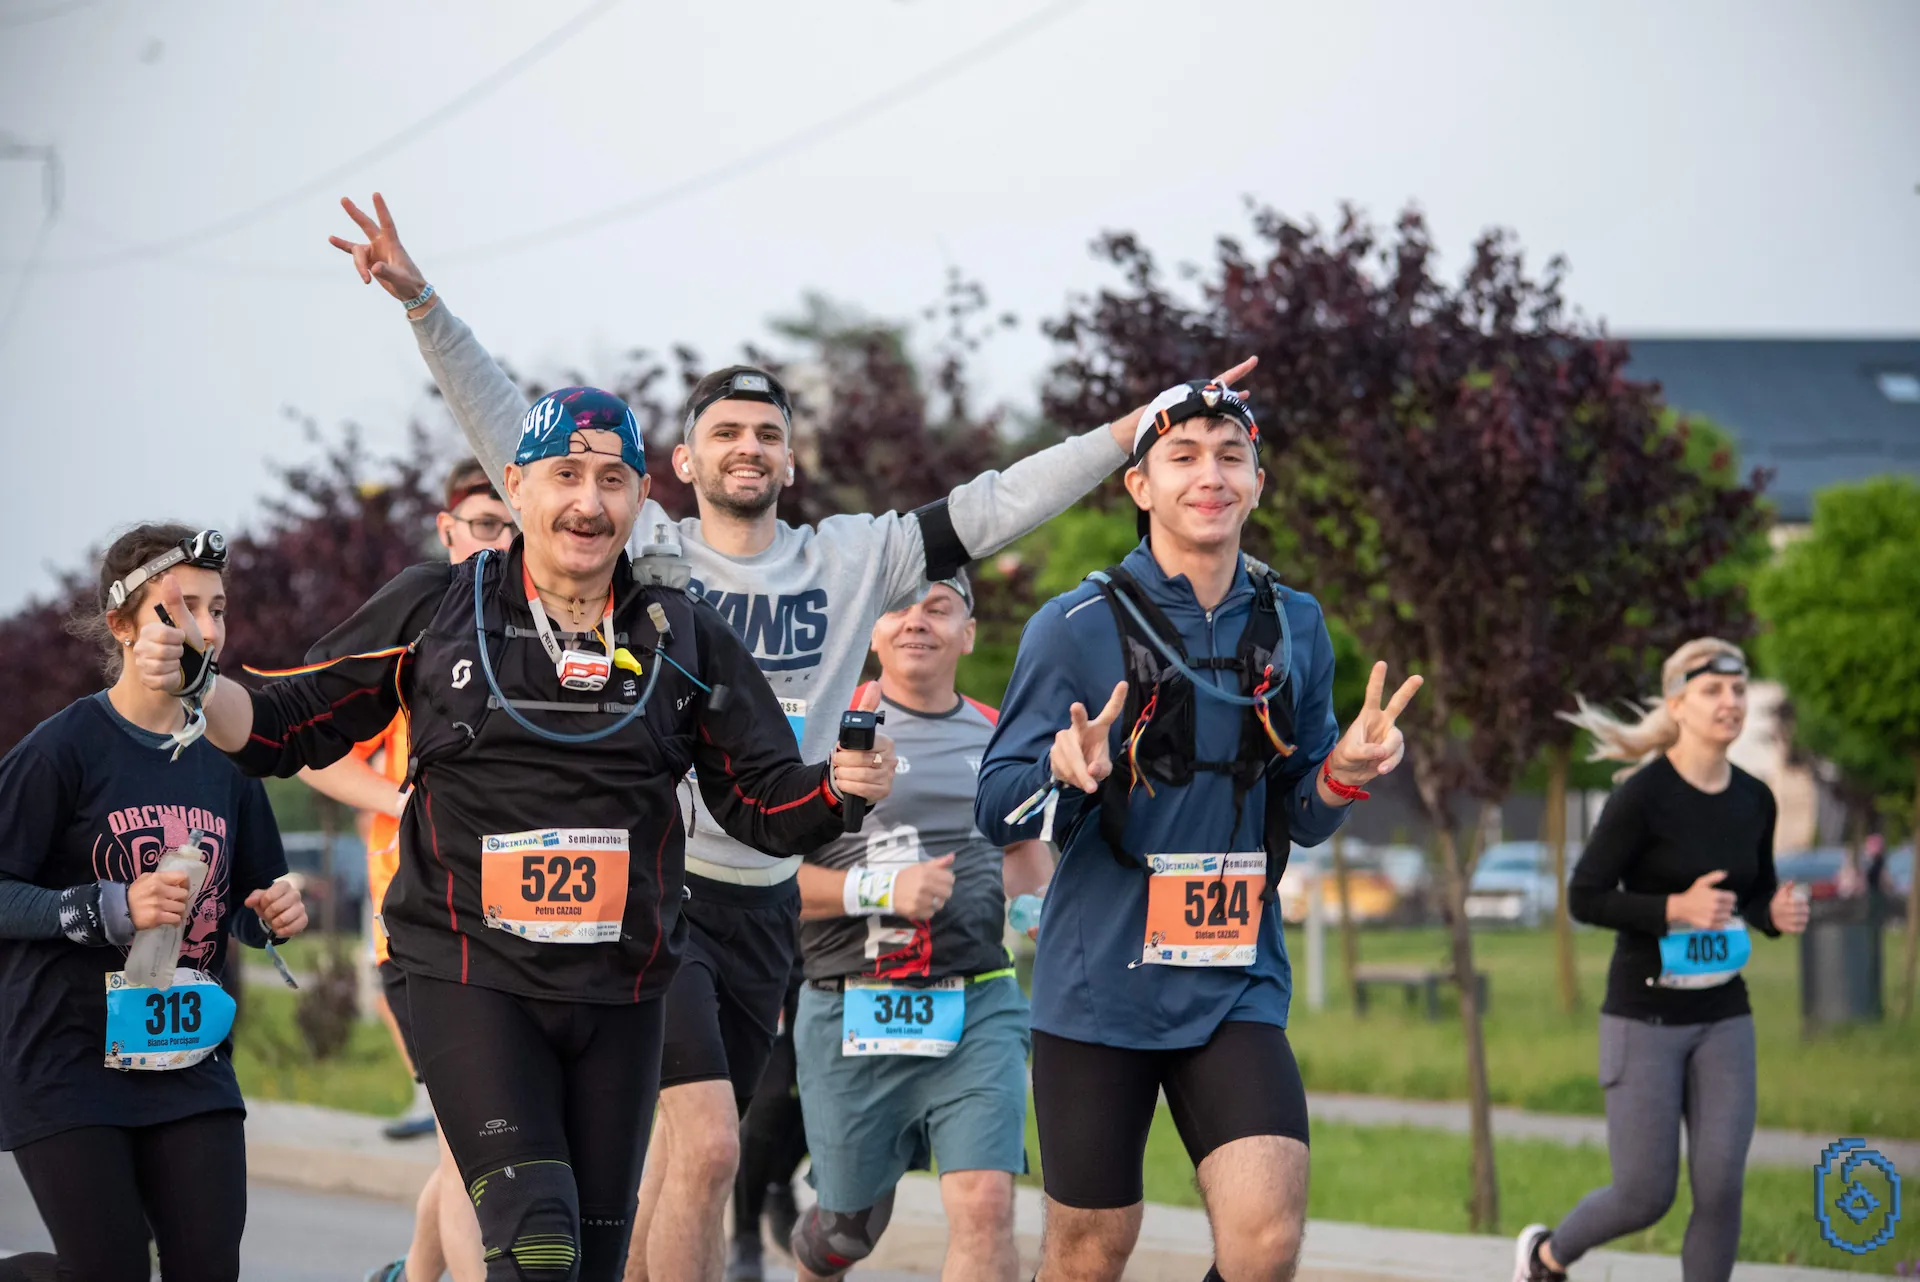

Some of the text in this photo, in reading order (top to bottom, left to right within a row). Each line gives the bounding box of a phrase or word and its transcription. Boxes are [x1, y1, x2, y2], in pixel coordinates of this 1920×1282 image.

[521, 855, 596, 903] 523
[535, 906, 582, 916] Petru CAZACU
[1184, 880, 1250, 927] 524
[1687, 934, 1729, 963] 403
[145, 991, 202, 1036] 313
[874, 994, 934, 1025] 343
[147, 1038, 169, 1047] Bianca
